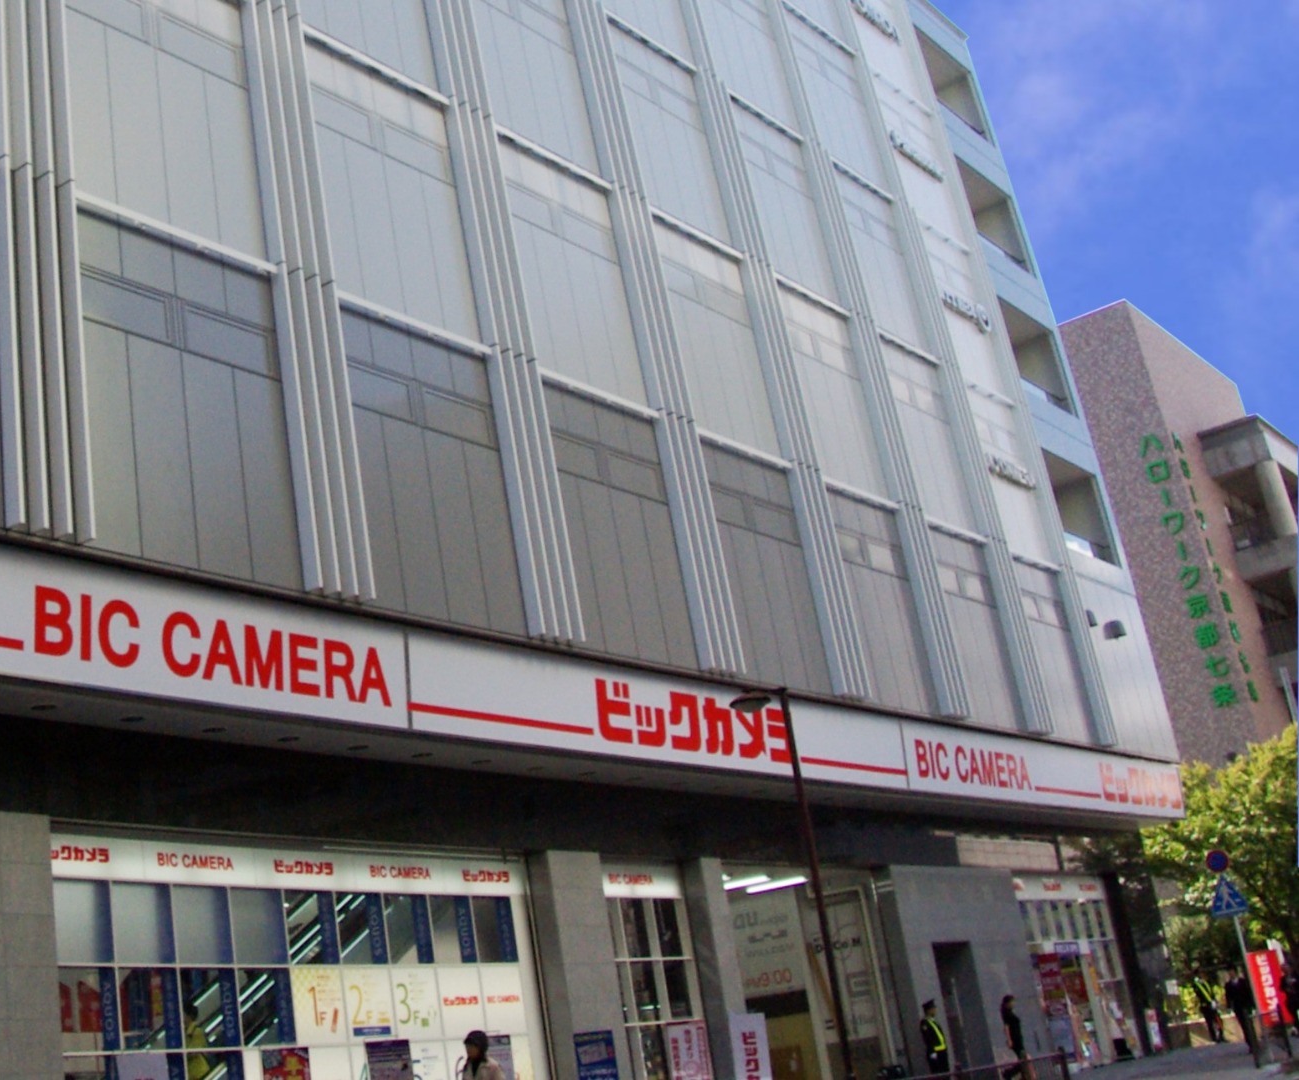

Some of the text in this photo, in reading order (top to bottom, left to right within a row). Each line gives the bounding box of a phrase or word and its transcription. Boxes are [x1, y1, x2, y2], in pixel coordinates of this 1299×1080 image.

[33, 584, 392, 707] BIC CAMERA
[594, 678, 794, 764] ビックカメラ
[914, 738, 1032, 792] BIC CAMERA
[1101, 762, 1183, 809] ビックカメラ
[157, 852, 234, 871] BIC CAMERA
[274, 859, 334, 877] ビックカメラ
[369, 865, 432, 881] BIC CAMERA
[462, 869, 511, 884] ビックカメラ
[608, 873, 653, 885] BIC CAMERA
[368, 904, 383, 957] AQUOS
[102, 982, 115, 1041] AQUOS
[223, 980, 236, 1038] AQUOS
[308, 985, 328, 1027] 1F
[349, 984, 373, 1026] 2F
[397, 983, 421, 1025] 3F
